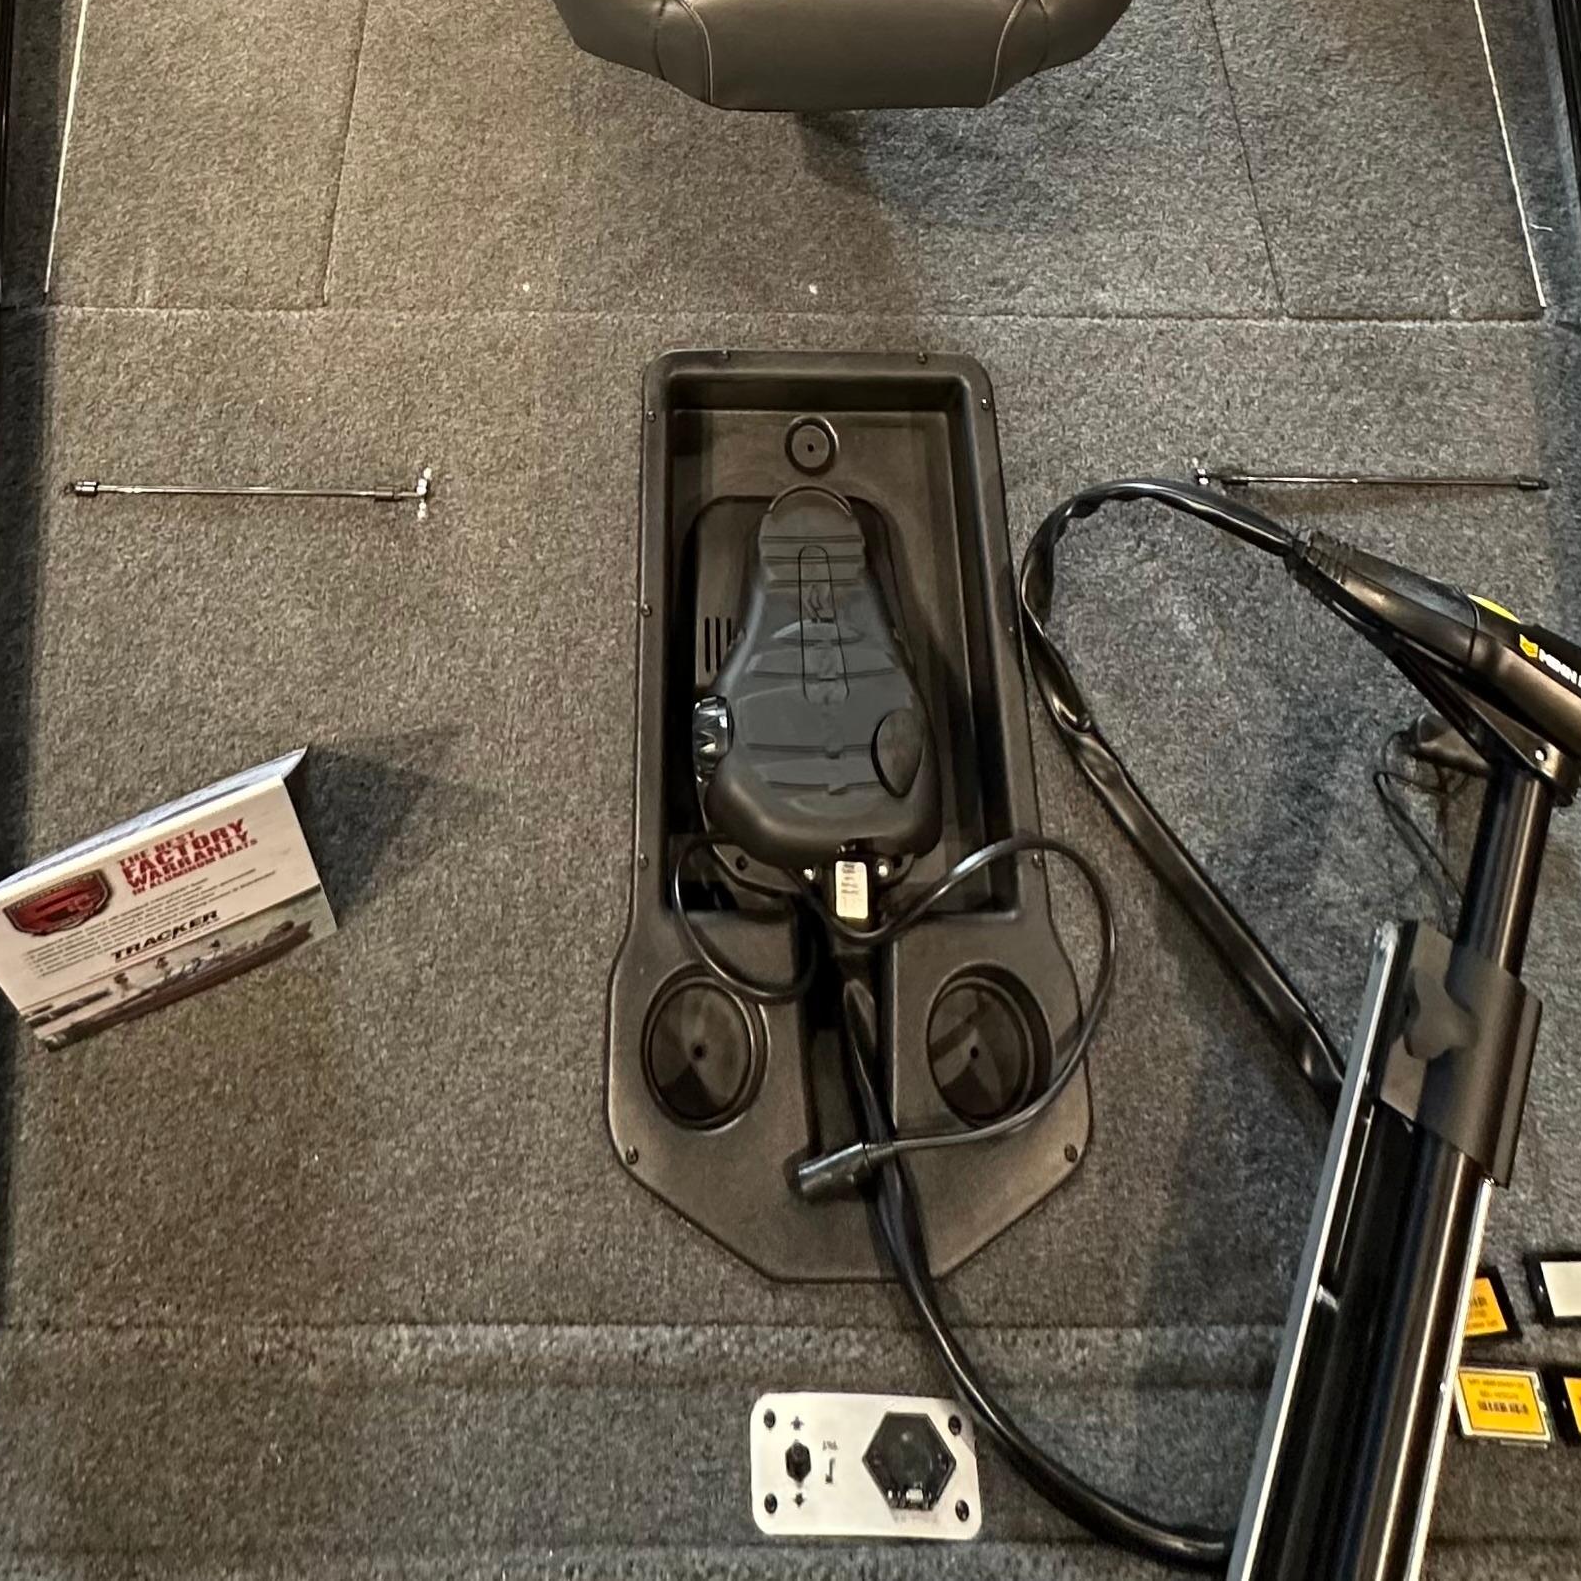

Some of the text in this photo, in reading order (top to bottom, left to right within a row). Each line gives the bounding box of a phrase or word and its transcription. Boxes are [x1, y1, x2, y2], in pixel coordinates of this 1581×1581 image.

[118, 829, 195, 867] THE BEST
[122, 818, 244, 880] FACTORY
[127, 830, 249, 889] WARRANTY
[219, 838, 258, 859] BOATS
[111, 910, 218, 960] TRACKER
